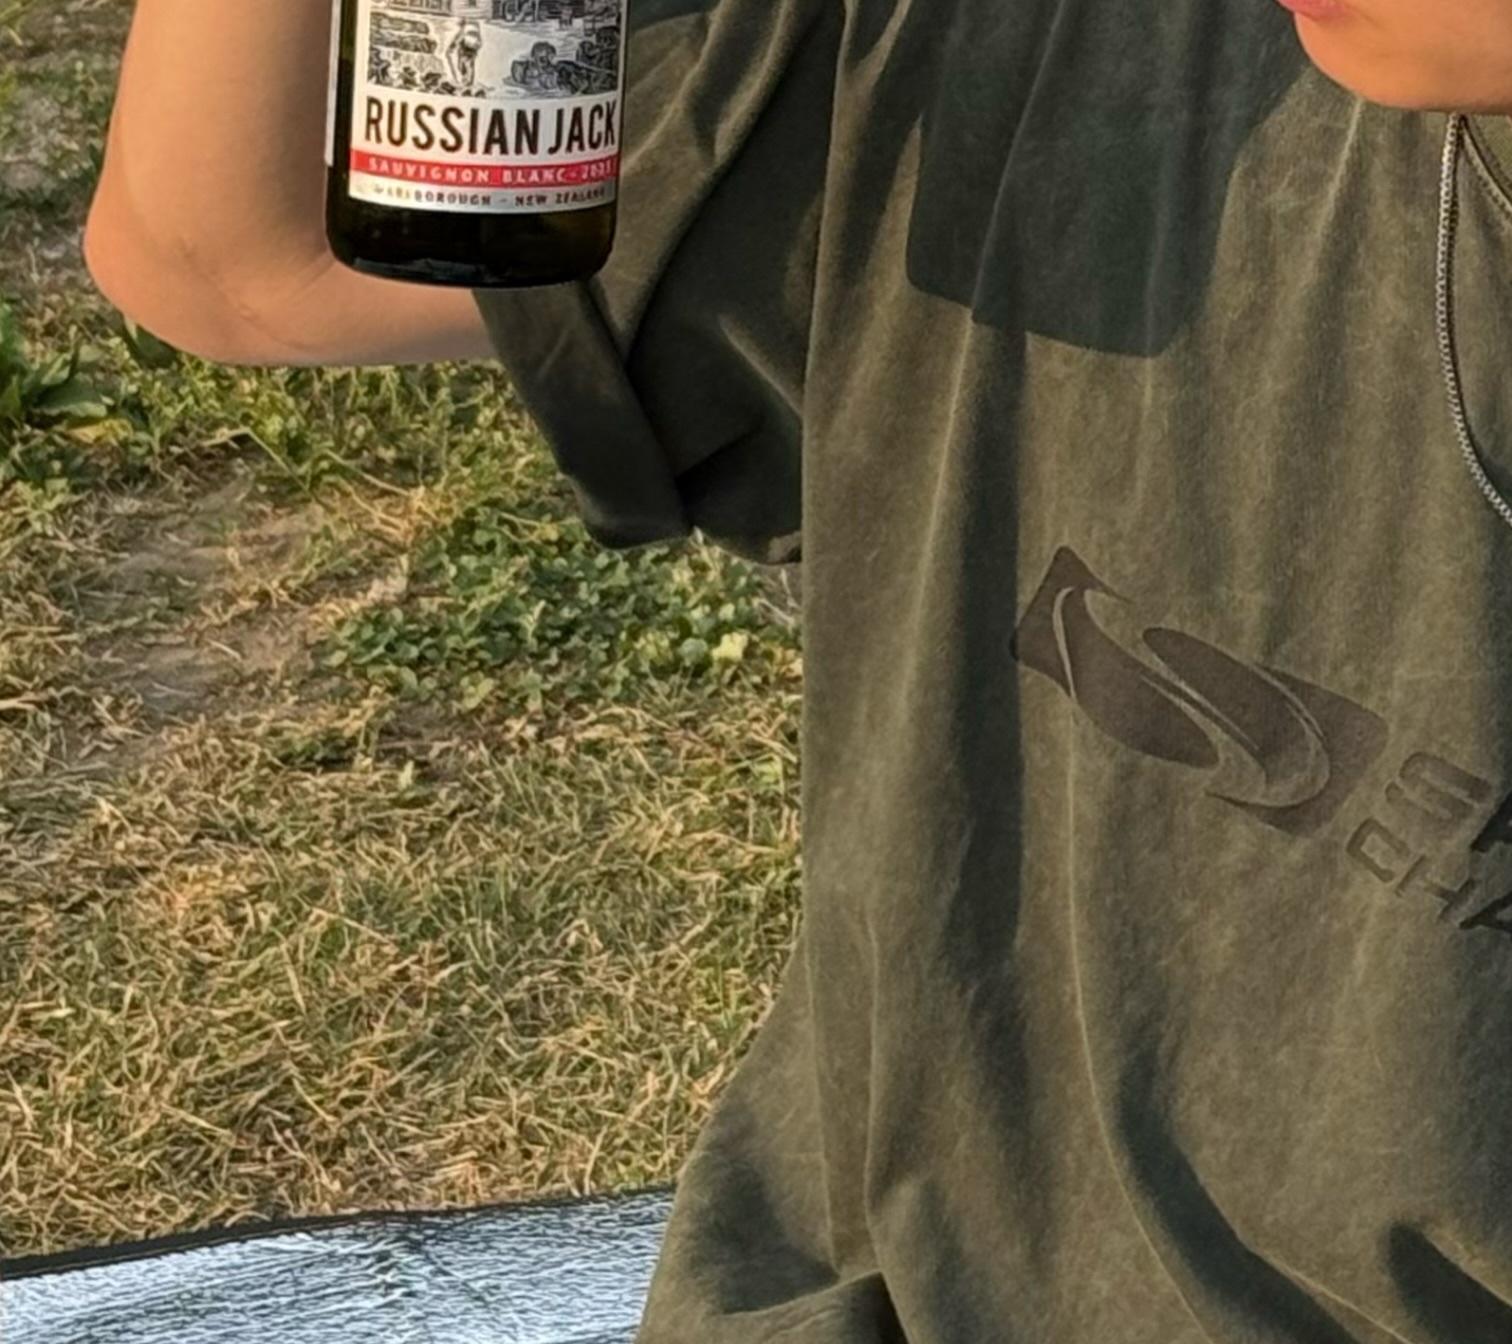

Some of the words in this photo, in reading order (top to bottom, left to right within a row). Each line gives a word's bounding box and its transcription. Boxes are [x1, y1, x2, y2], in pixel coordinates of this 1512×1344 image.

[365, 96, 540, 155] RUSSIAN
[547, 100, 617, 154] JACK
[368, 158, 490, 183] SAUVIGNON
[502, 167, 566, 184] BLANC
[515, 194, 547, 206] NEW
